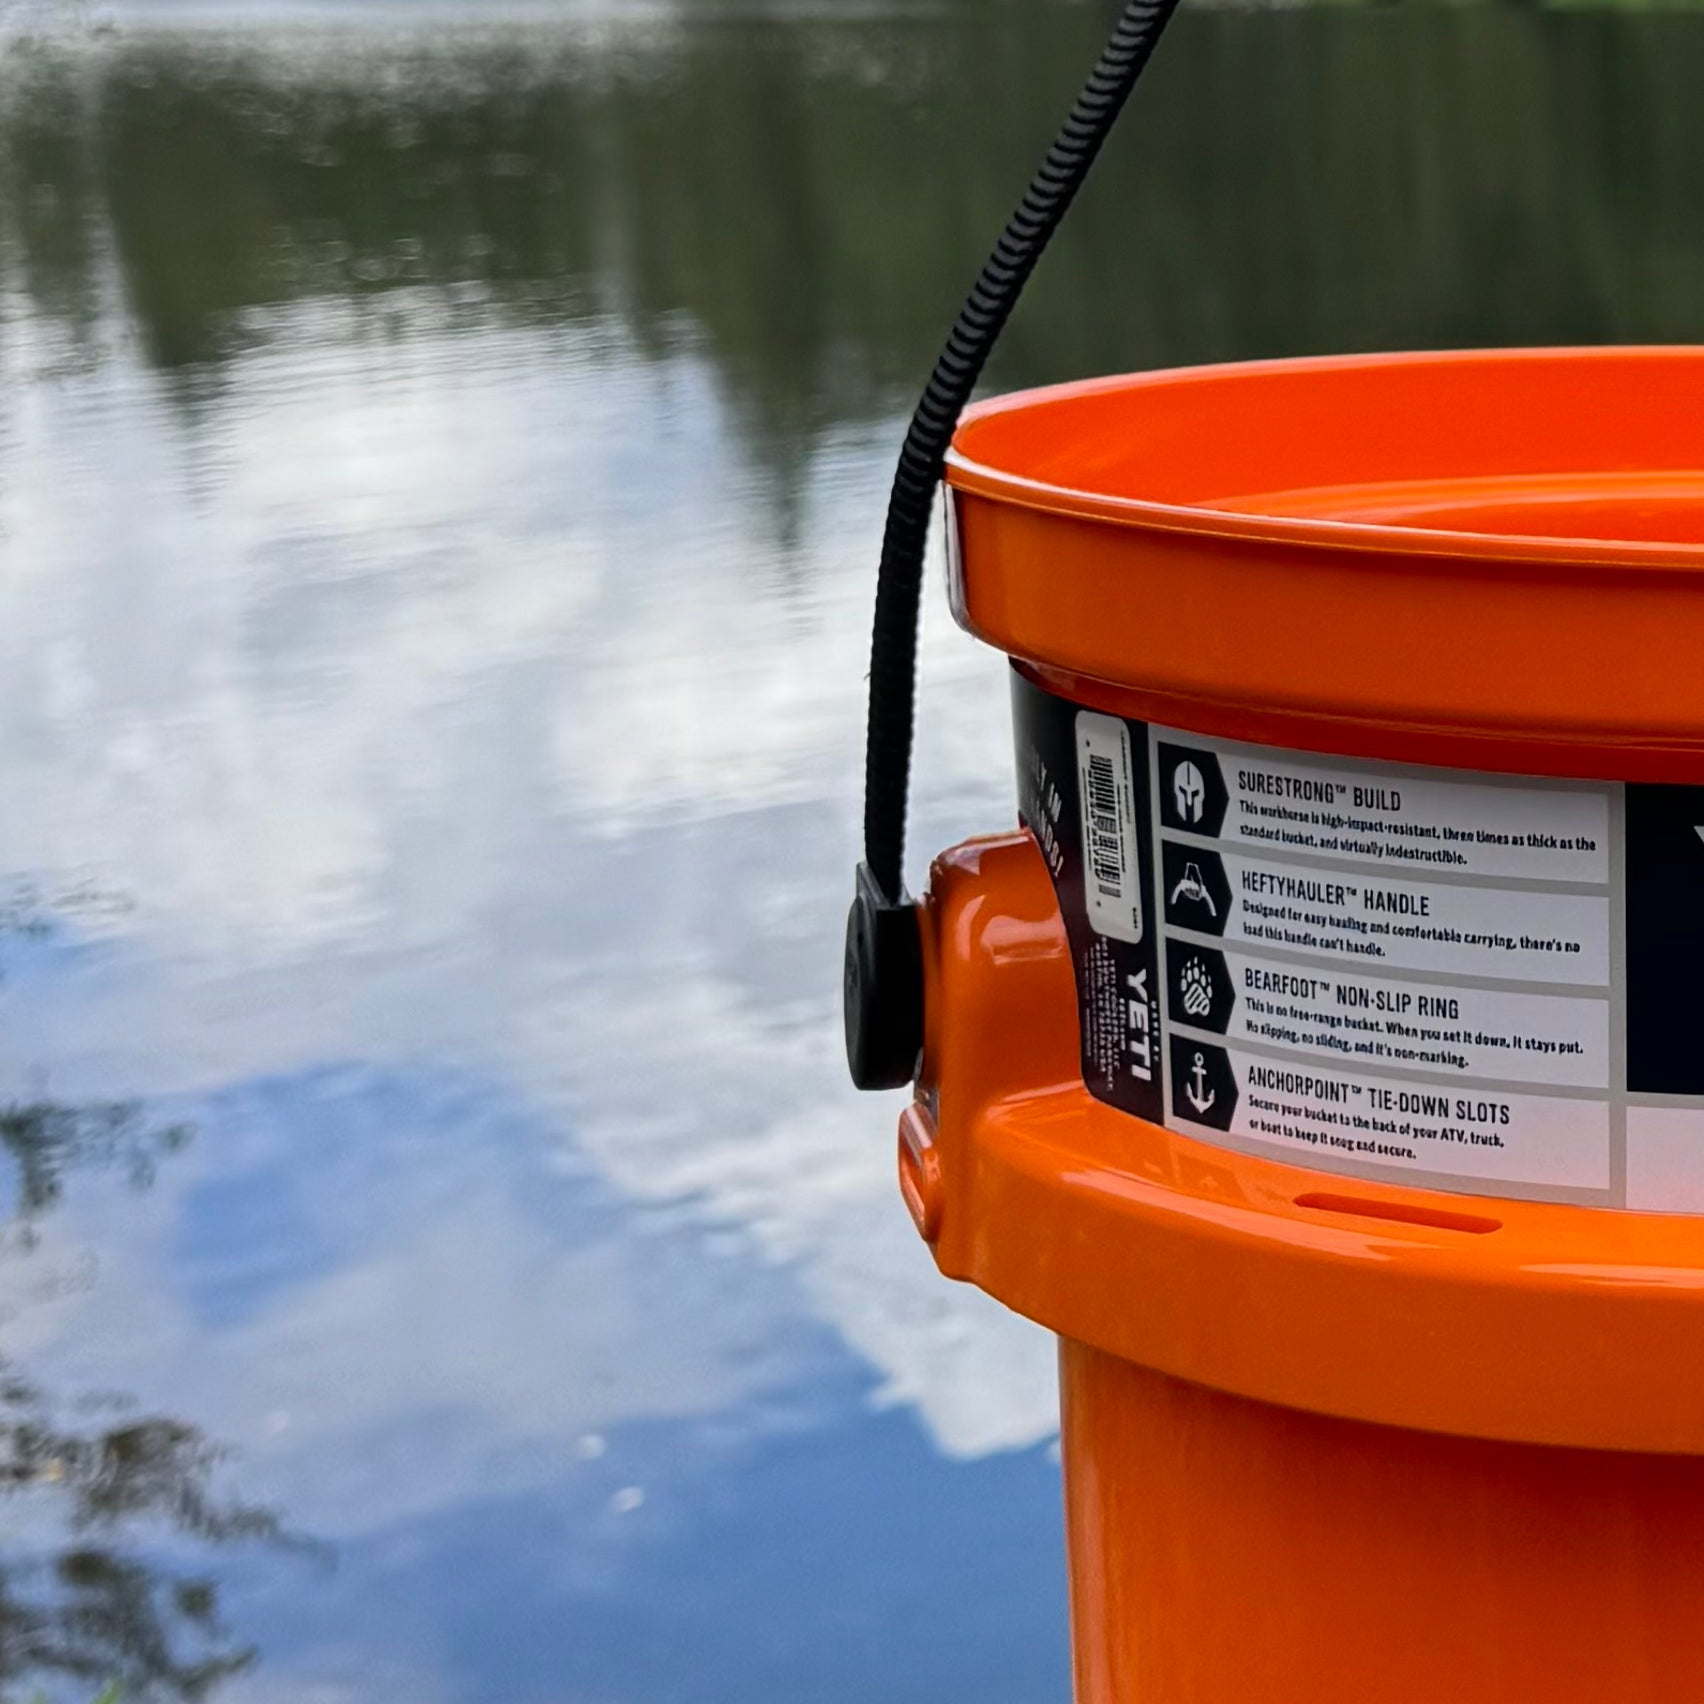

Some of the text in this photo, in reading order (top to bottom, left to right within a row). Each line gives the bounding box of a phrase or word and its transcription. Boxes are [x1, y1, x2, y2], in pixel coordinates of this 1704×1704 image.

[1353, 786, 1401, 812] BUILD
[1239, 800, 1259, 815] This
[1260, 805, 1309, 823] workhorse
[1311, 811, 1320, 825] is
[1443, 827, 1474, 842] three
[1477, 830, 1509, 845] times
[1512, 835, 1524, 846] as
[1527, 833, 1558, 849] thick
[1560, 838, 1573, 850] as
[1576, 837, 1596, 851] the
[1240, 824, 1280, 841] standard
[1320, 837, 1338, 851] and
[1340, 838, 1383, 858] virtually
[1385, 845, 1467, 865] indestructible.
[1364, 889, 1430, 917] HANDLE
[1242, 900, 1581, 953] Designed for easy hauling and comfortable carrying, there's no
[1243, 921, 1386, 957] load this handle can't handle.
[1336, 984, 1412, 1014] NON-SLIP
[1418, 995, 1459, 1020] RING
[1127, 969, 1151, 1081] YETI
[1245, 997, 1264, 1013] This
[1266, 1002, 1274, 1015] is
[1276, 1006, 1288, 1017] no
[1290, 1005, 1342, 1028] free-range
[1344, 1015, 1384, 1033] bucket.
[1386, 1021, 1417, 1038] When
[1420, 1028, 1441, 1041] you
[1443, 1030, 1460, 1042] set
[1525, 1038, 1556, 1054] stays
[1559, 1041, 1583, 1055] put.
[1246, 1019, 1259, 1033] No
[1302, 1033, 1313, 1044] no
[1354, 1041, 1374, 1055] and
[1376, 1042, 1392, 1057] it's
[1394, 1049, 1470, 1069] non-marking.
[1249, 1095, 1279, 1113] Secure
[1281, 1104, 1303, 1117] your
[1304, 1106, 1338, 1124] bucket
[1340, 1113, 1351, 1126] to
[1352, 1116, 1370, 1130] the
[1372, 1117, 1397, 1133] back
[1399, 1122, 1410, 1136] of
[1413, 1127, 1438, 1139] your
[1440, 1128, 1468, 1144] ATV,
[1367, 1088, 1449, 1118] TIE-DOWN
[1456, 1100, 1510, 1125] SLOTS
[1249, 1119, 1259, 1129] or
[1261, 1118, 1281, 1136] boat
[1283, 1124, 1293, 1137] to
[1295, 1126, 1318, 1145] keep
[1320, 1132, 1328, 1145] it
[1356, 1138, 1376, 1153] and
[1377, 1143, 1416, 1160] secure.
